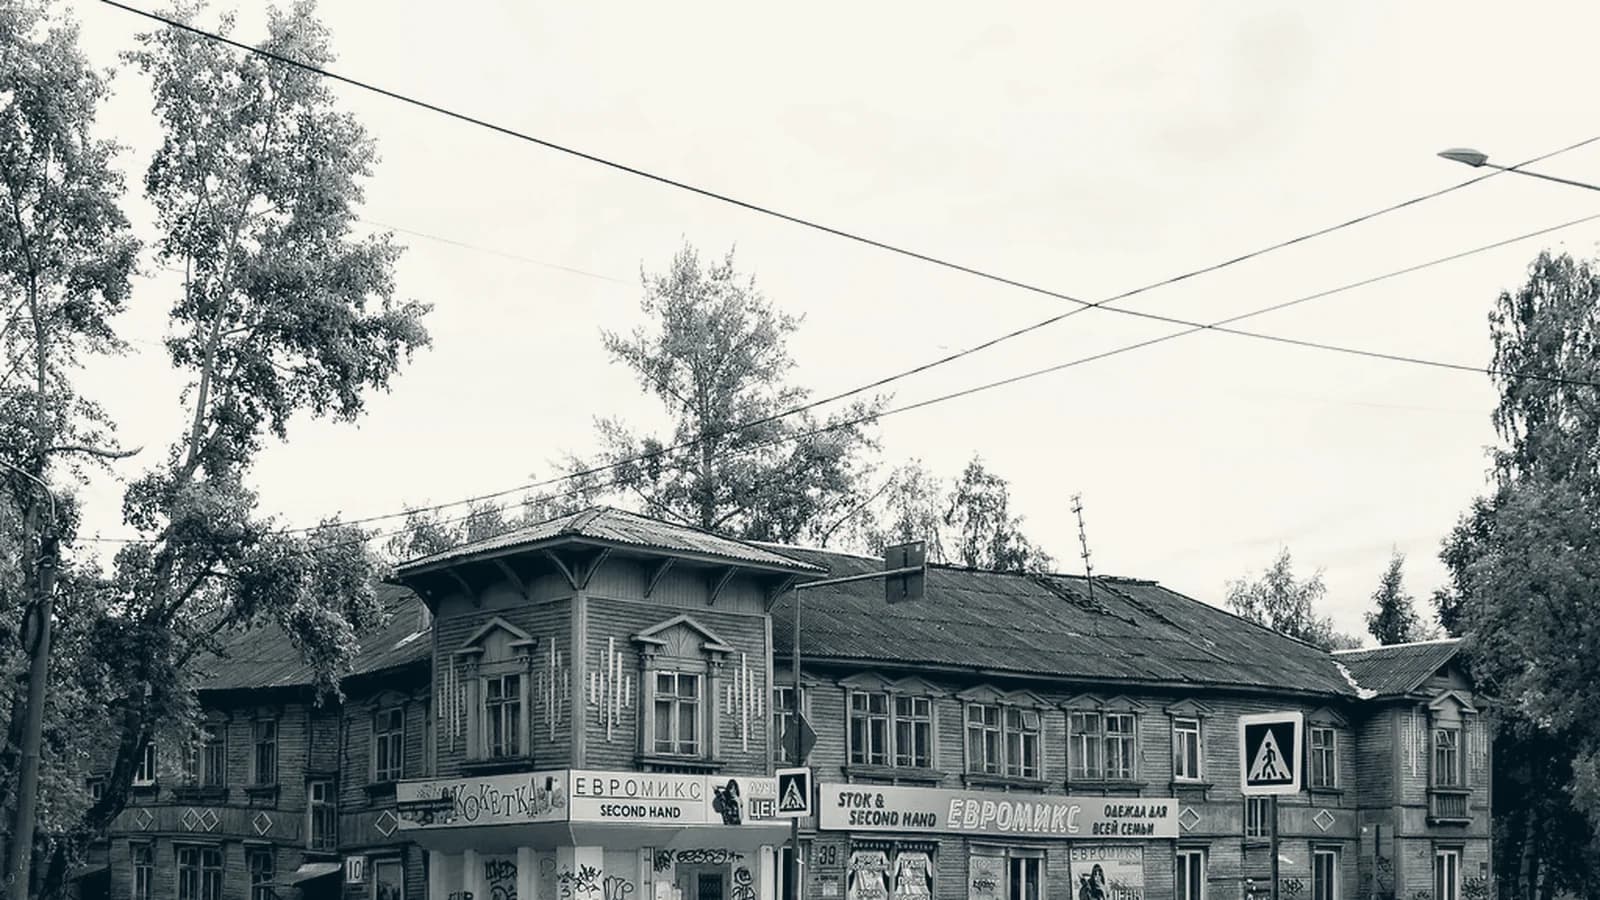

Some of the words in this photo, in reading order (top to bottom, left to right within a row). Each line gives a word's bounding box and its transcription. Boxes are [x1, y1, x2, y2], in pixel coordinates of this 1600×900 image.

[575, 777, 701, 799] ЕВРОМИКС
[452, 777, 538, 821] КОКЕТКА
[838, 791, 872, 808] STOK
[875, 793, 885, 808] &
[600, 804, 646, 818] SECOND
[649, 806, 681, 818] HAND
[849, 810, 899, 826] SECOND
[902, 811, 937, 827] HAND
[947, 798, 1081, 833] ЕВРОМИКС
[1104, 804, 1147, 818] ОДЕЖДА
[1148, 805, 1168, 818] ДЛЯ
[1092, 820, 1119, 836] ВСЕЙ
[1121, 822, 1154, 836] СЕМЬИ
[819, 845, 836, 865] 39
